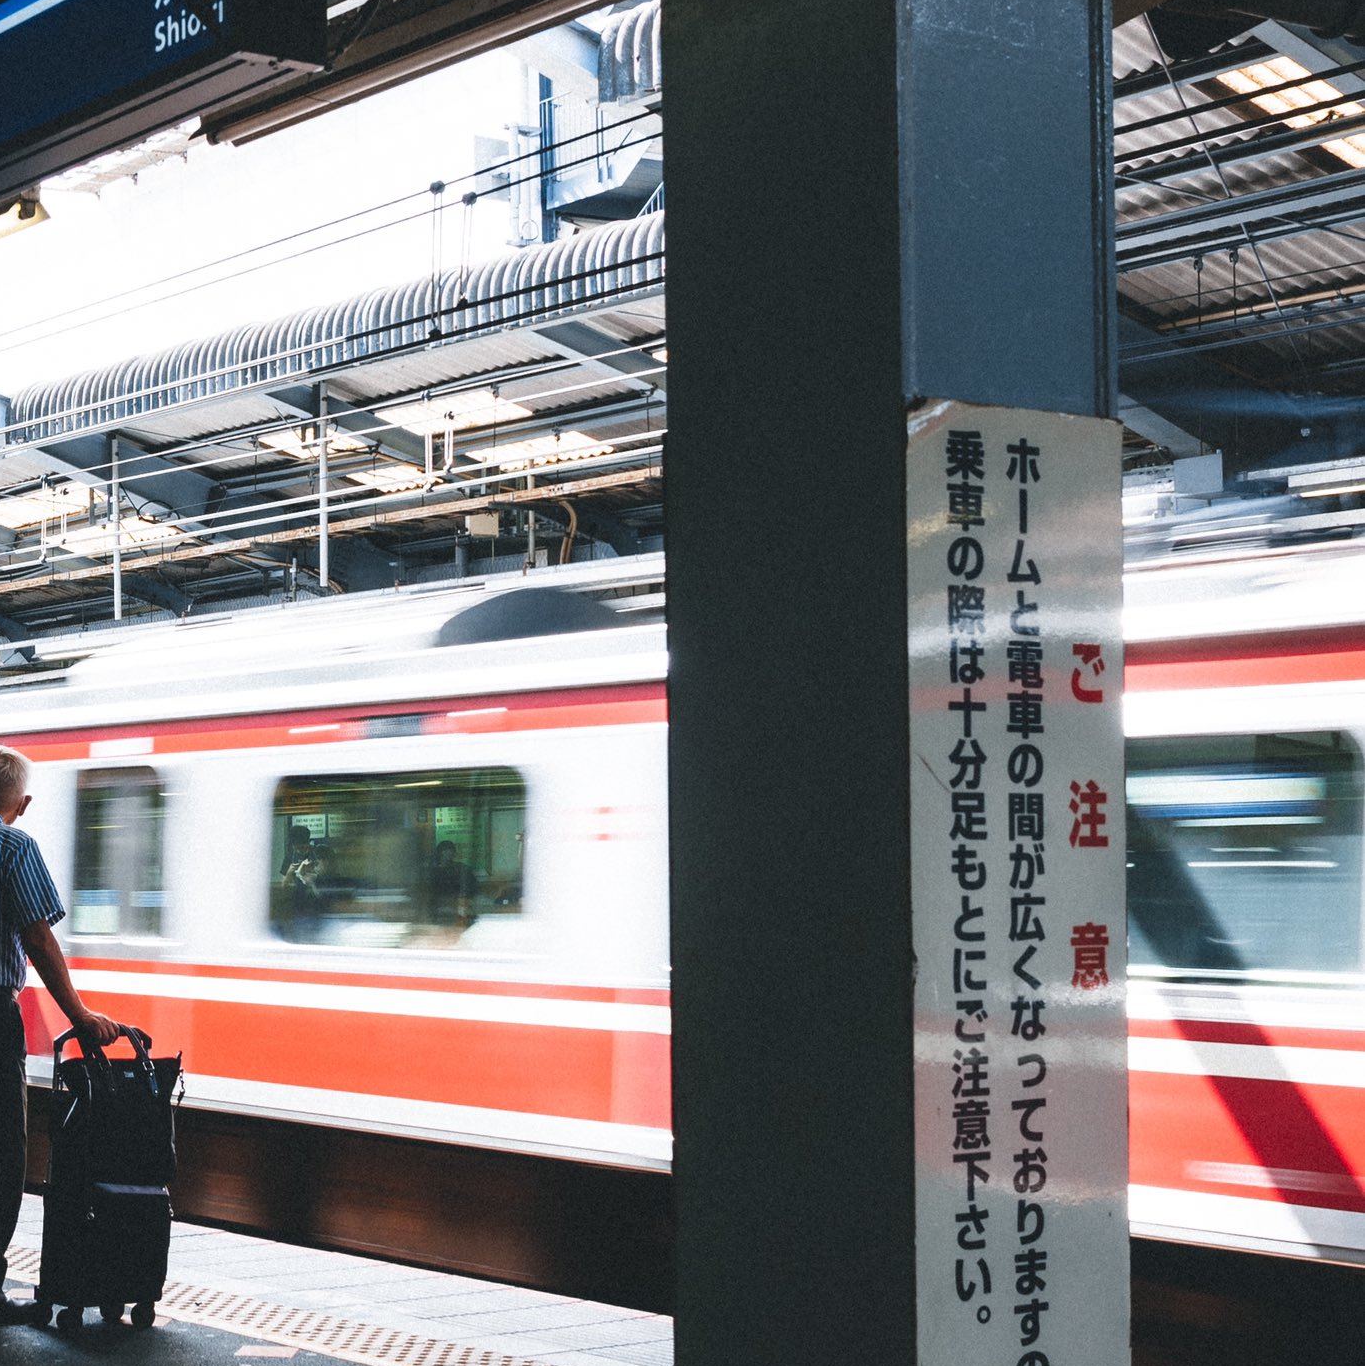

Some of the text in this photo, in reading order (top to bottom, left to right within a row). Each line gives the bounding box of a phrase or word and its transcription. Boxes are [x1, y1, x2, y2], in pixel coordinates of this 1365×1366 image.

[946, 430, 991, 1324] 乗車の際は十分足もとにご注意下さい。
[1069, 643, 1109, 990] ご注意
